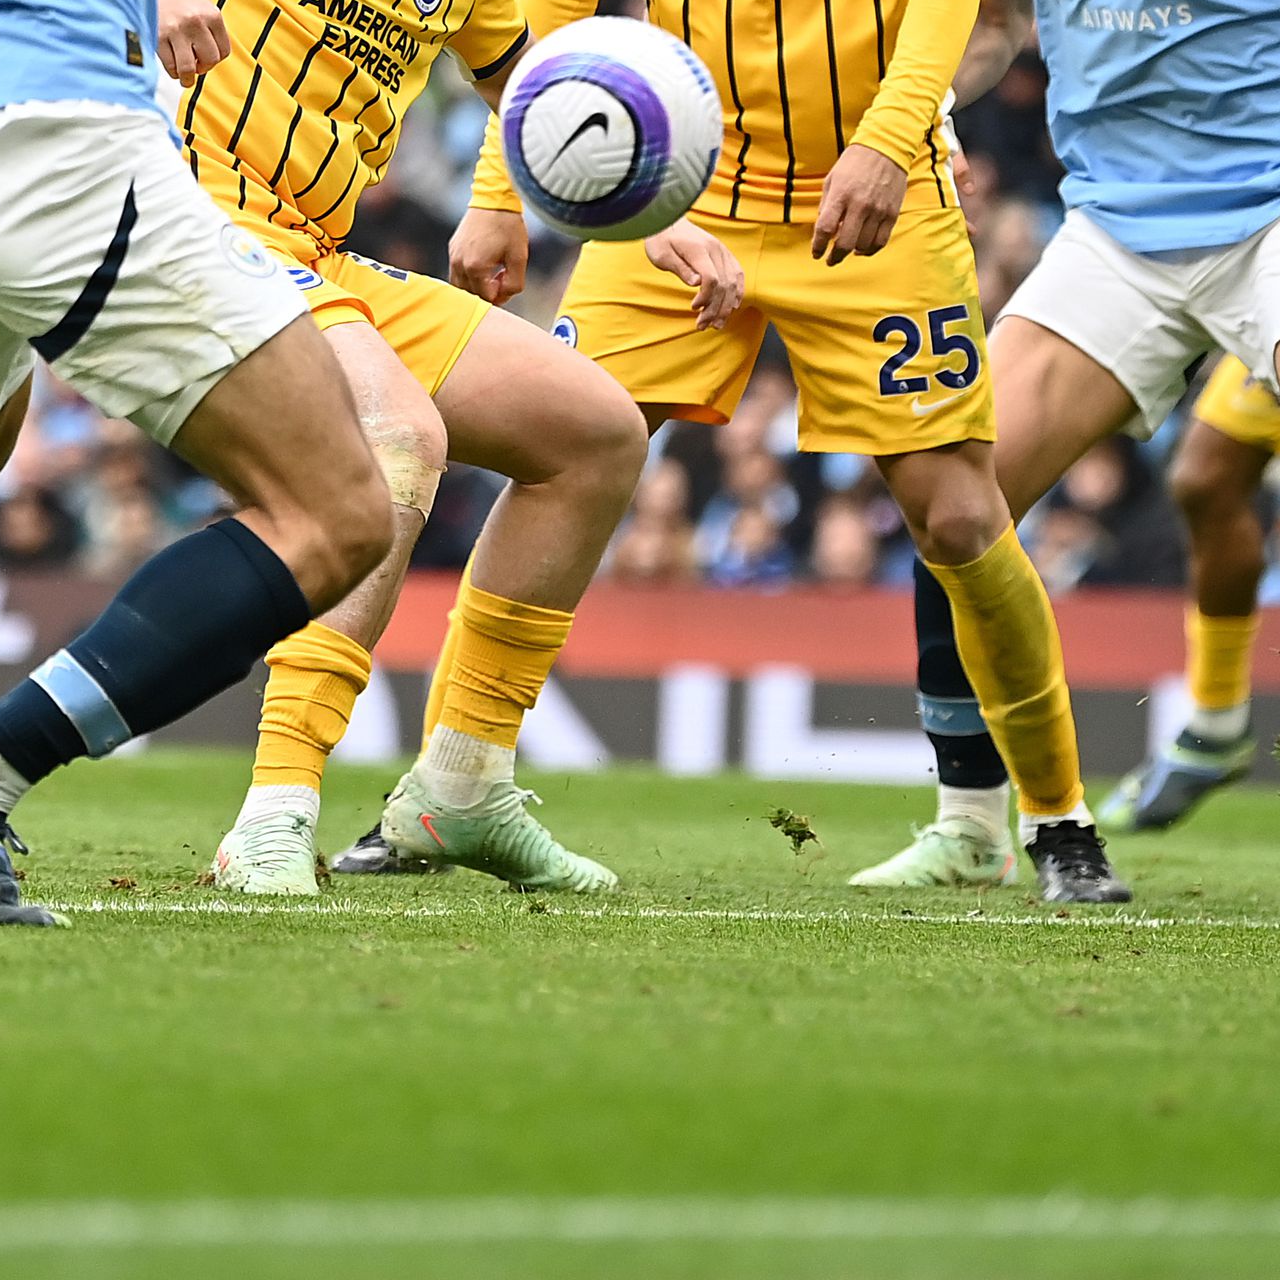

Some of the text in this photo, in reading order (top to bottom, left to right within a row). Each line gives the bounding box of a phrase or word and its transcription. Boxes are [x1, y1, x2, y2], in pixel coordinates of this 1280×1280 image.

[1081, 4, 1193, 32] AIRWAYS
[320, 22, 405, 95] EXPRESS
[873, 304, 980, 395] 25
